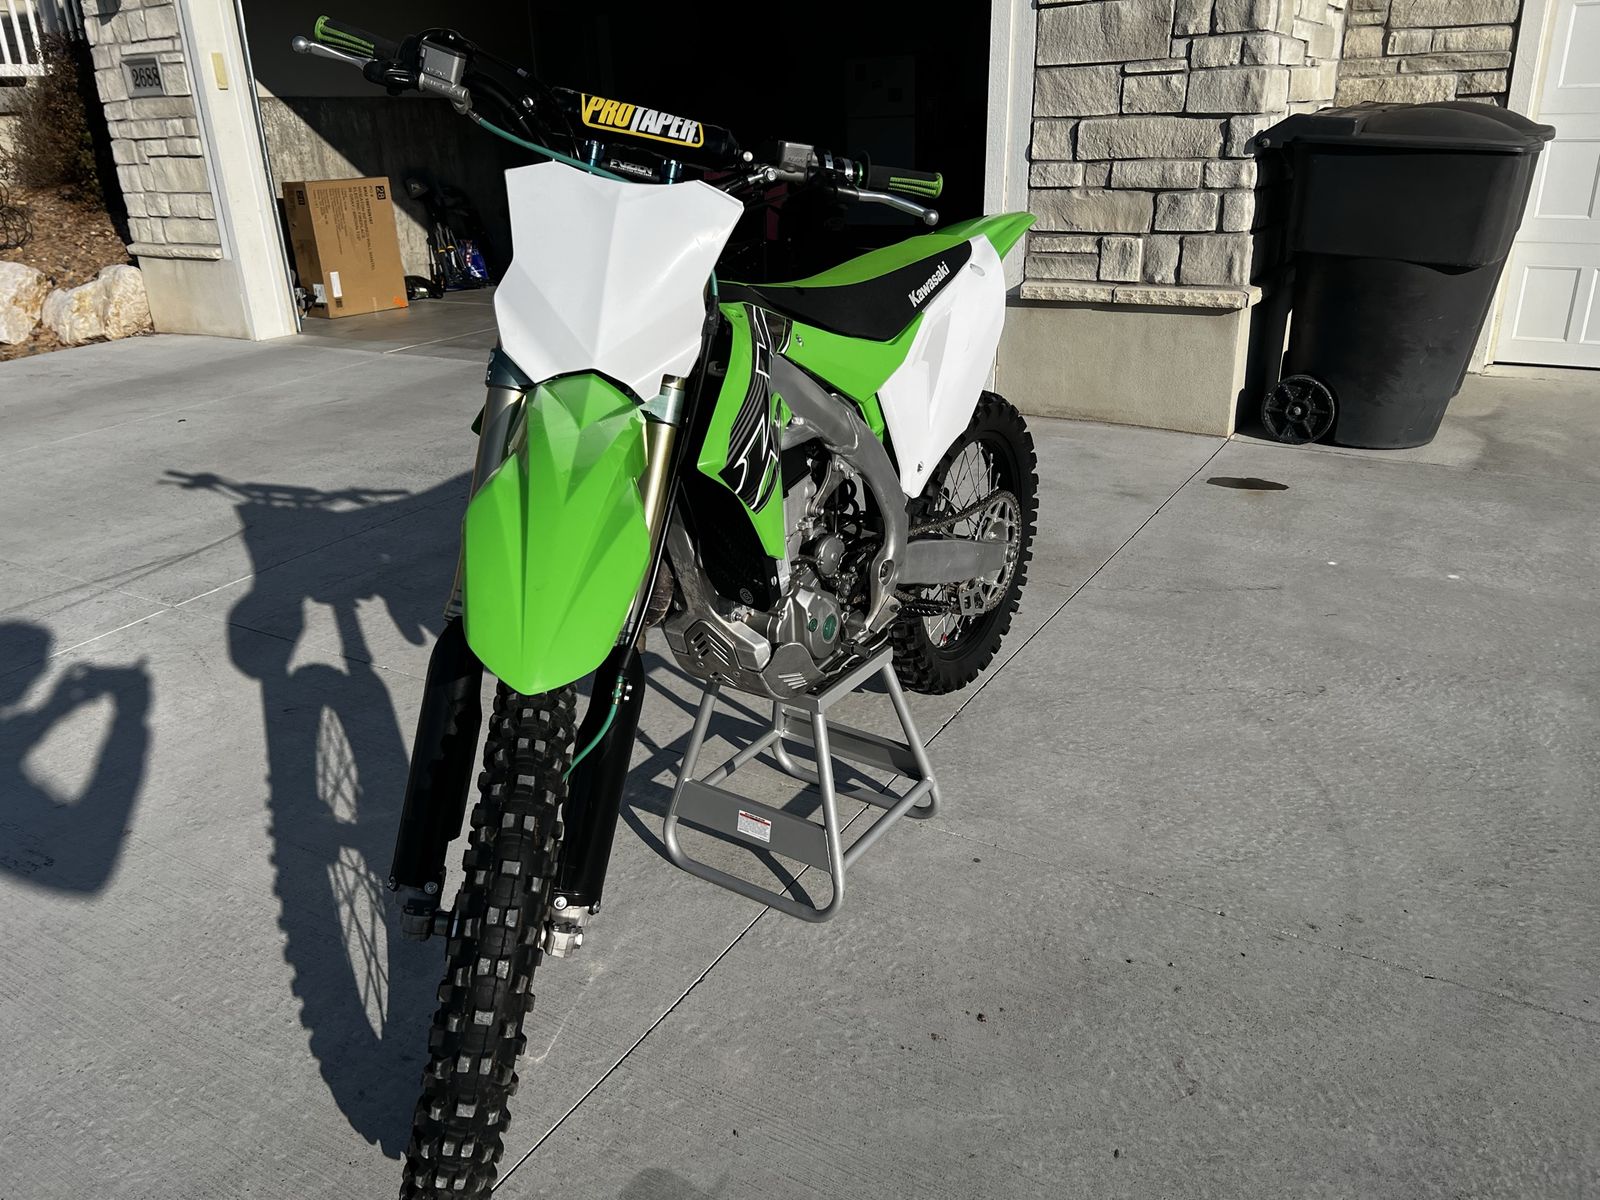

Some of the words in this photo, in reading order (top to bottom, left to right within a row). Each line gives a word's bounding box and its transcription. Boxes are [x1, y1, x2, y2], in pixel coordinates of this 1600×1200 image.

[132, 67, 160, 87] 2688
[376, 187, 385, 199] 28
[908, 260, 950, 308] Kawasaki
